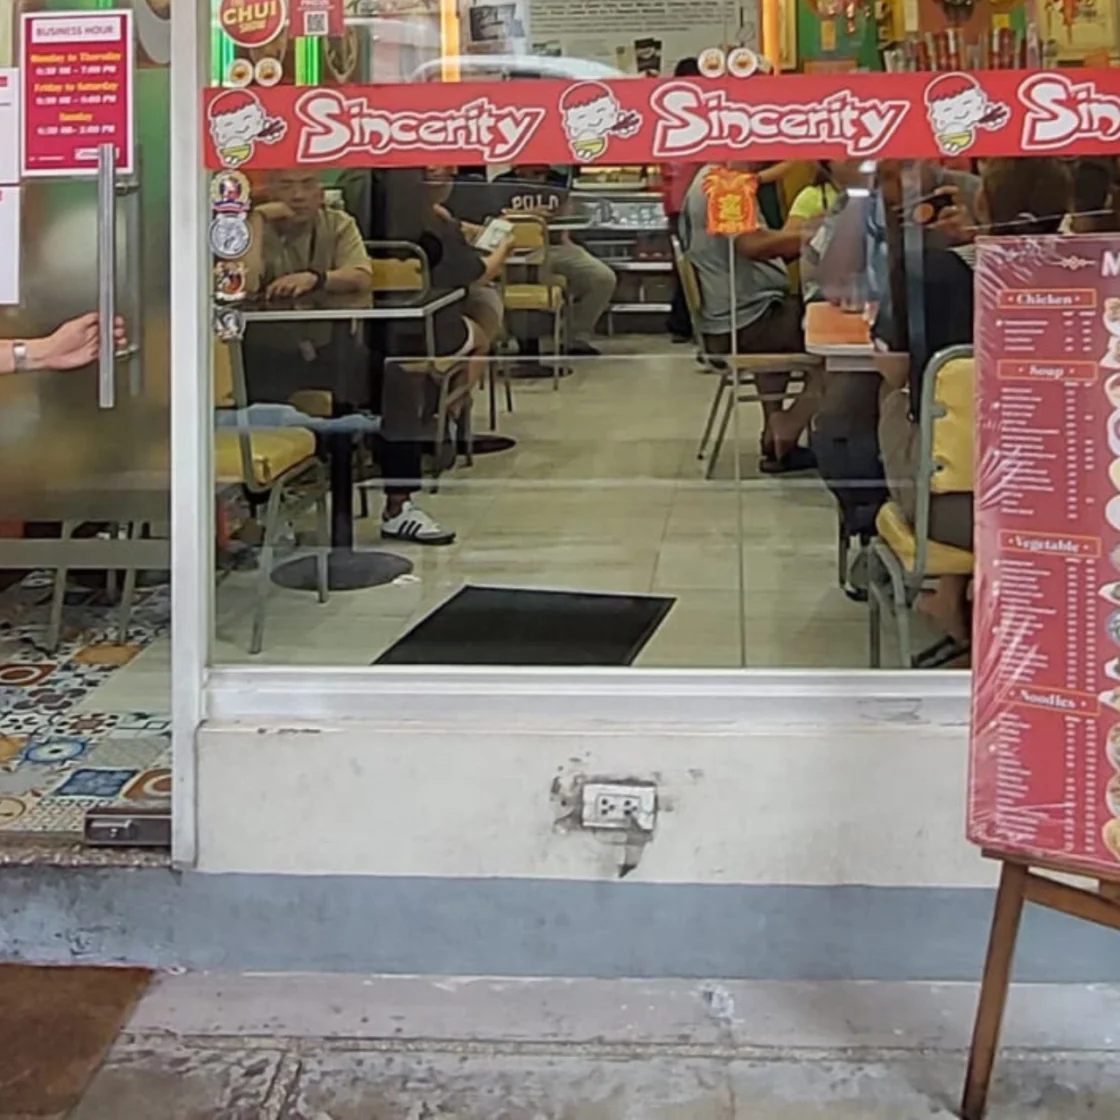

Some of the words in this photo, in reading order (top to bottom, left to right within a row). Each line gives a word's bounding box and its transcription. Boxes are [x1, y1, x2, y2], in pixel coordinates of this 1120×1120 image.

[223, 0, 278, 25] CHUI
[36, 25, 83, 36] BUSINESS
[85, 25, 114, 35] HOUR
[296, 88, 544, 163] Sincerity
[650, 81, 909, 156] Sincerity
[1016, 292, 1073, 305] Chicken
[1029, 365, 1064, 378] Soup
[1013, 536, 1080, 552] Vegetable
[1020, 688, 1077, 709] Noodles
